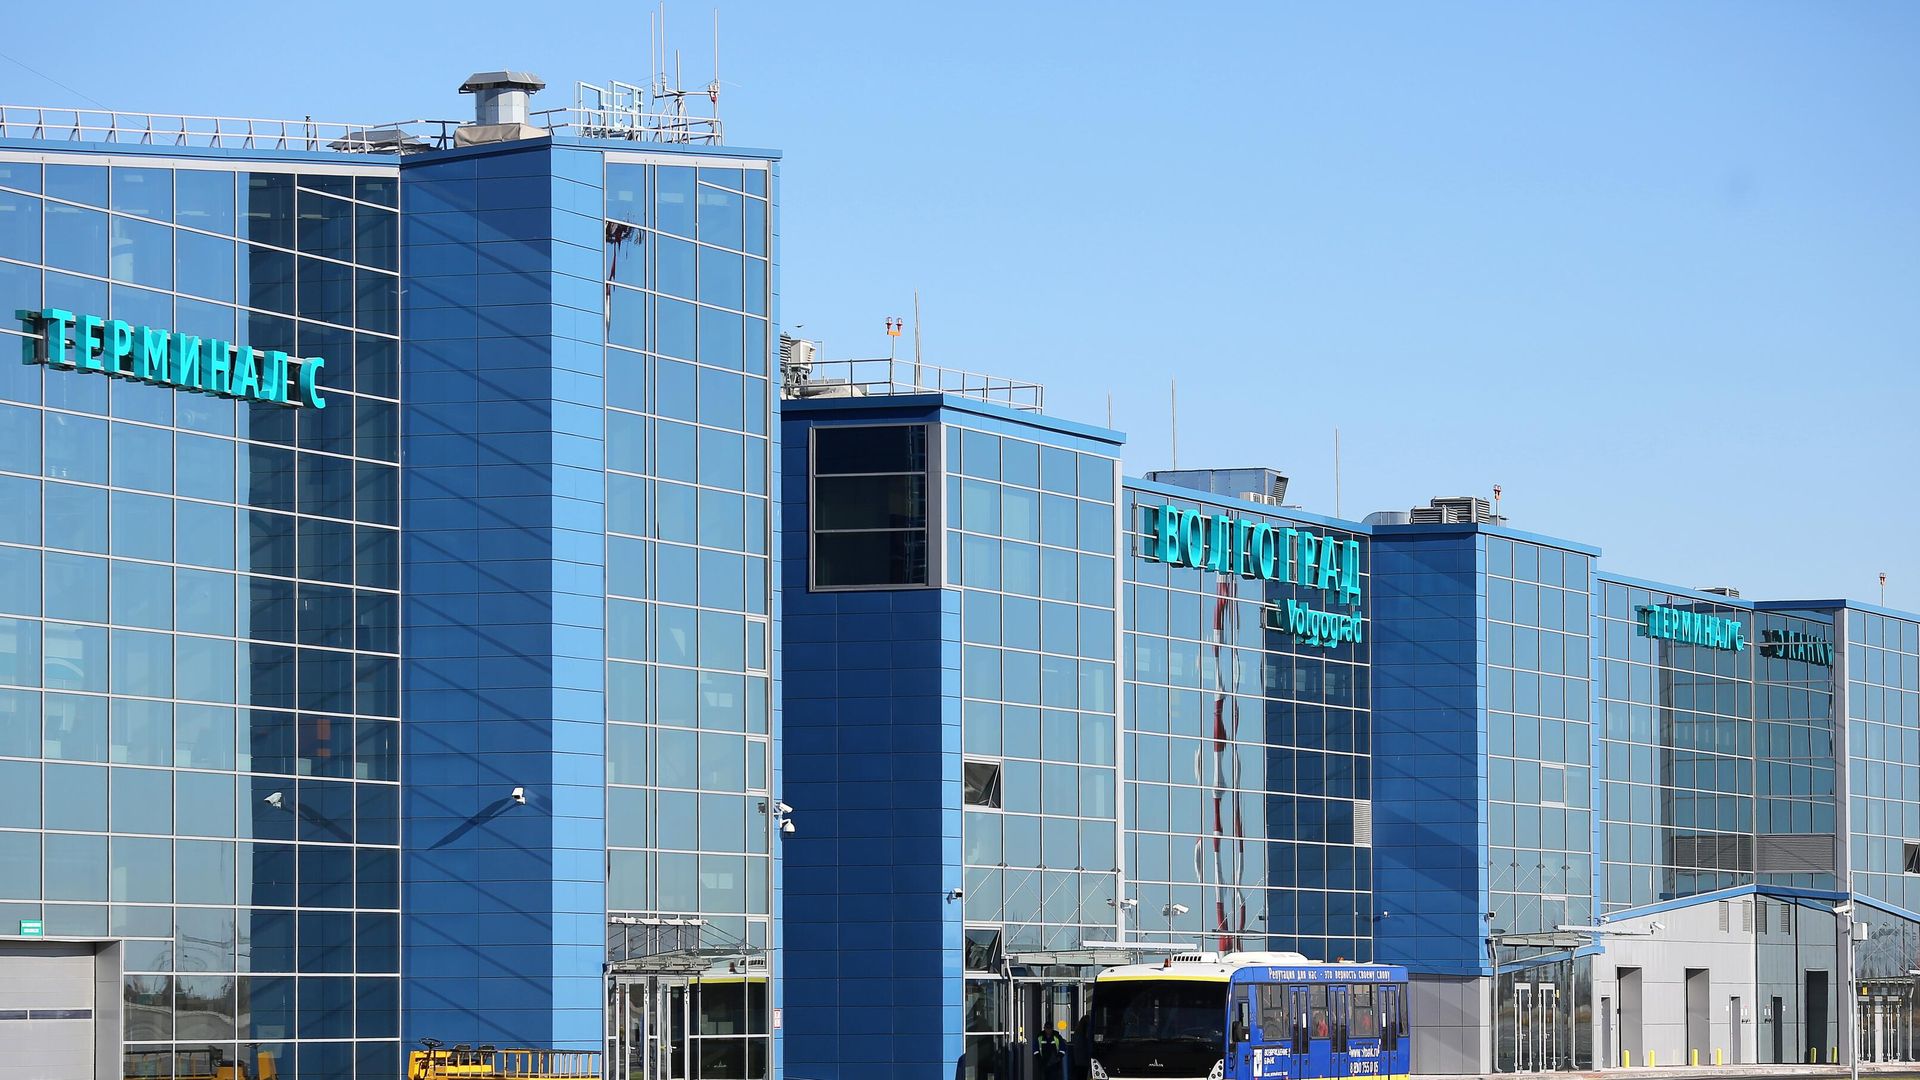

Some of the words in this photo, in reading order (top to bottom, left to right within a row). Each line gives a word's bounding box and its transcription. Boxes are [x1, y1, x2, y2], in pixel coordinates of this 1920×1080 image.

[43, 308, 288, 402] ТЕРМИНАЛ
[300, 357, 326, 408] С
[1159, 505, 1361, 606] ВОЛГОГРАД
[1286, 599, 1362, 648] Volgograd
[1648, 605, 1731, 650] ТЕРМИНАЛ
